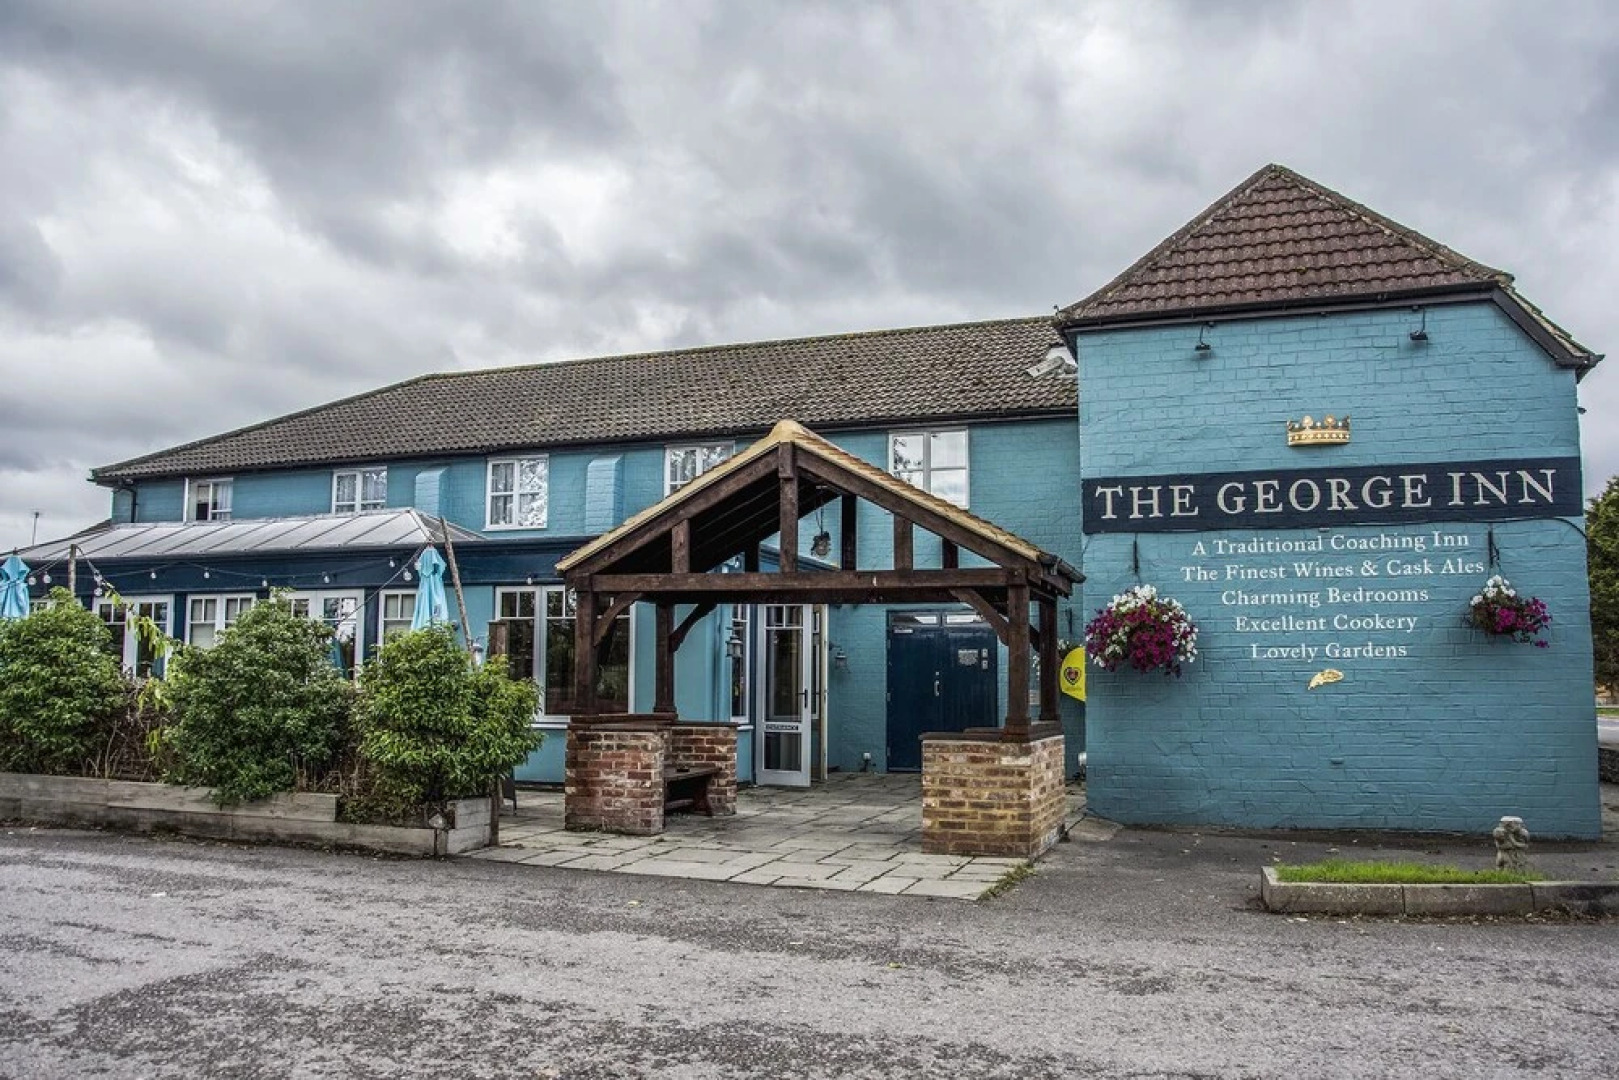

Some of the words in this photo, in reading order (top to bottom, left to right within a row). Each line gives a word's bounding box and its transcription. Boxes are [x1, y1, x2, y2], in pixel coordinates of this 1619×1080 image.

[1095, 485, 1199, 519] THE
[1216, 474, 1432, 514] GEORGE
[1447, 469, 1557, 506] INN
[1191, 541, 1206, 556] A
[1212, 536, 1323, 555] Traditional
[1330, 533, 1426, 552] Coaching
[1432, 530, 1470, 547] Inn
[1180, 566, 1218, 582] The
[1225, 564, 1286, 580] Finest
[1292, 561, 1354, 578] Wines
[1360, 559, 1379, 576] &
[1386, 558, 1434, 576] Cask
[1440, 557, 1484, 575] Ales
[1221, 589, 1321, 608] Charming
[1326, 586, 1429, 604] Bedrooms
[1235, 615, 1327, 632] Excellent
[1333, 613, 1418, 633] Cookery
[1250, 643, 1319, 663] Lovely
[1325, 641, 1408, 659] Gardens
